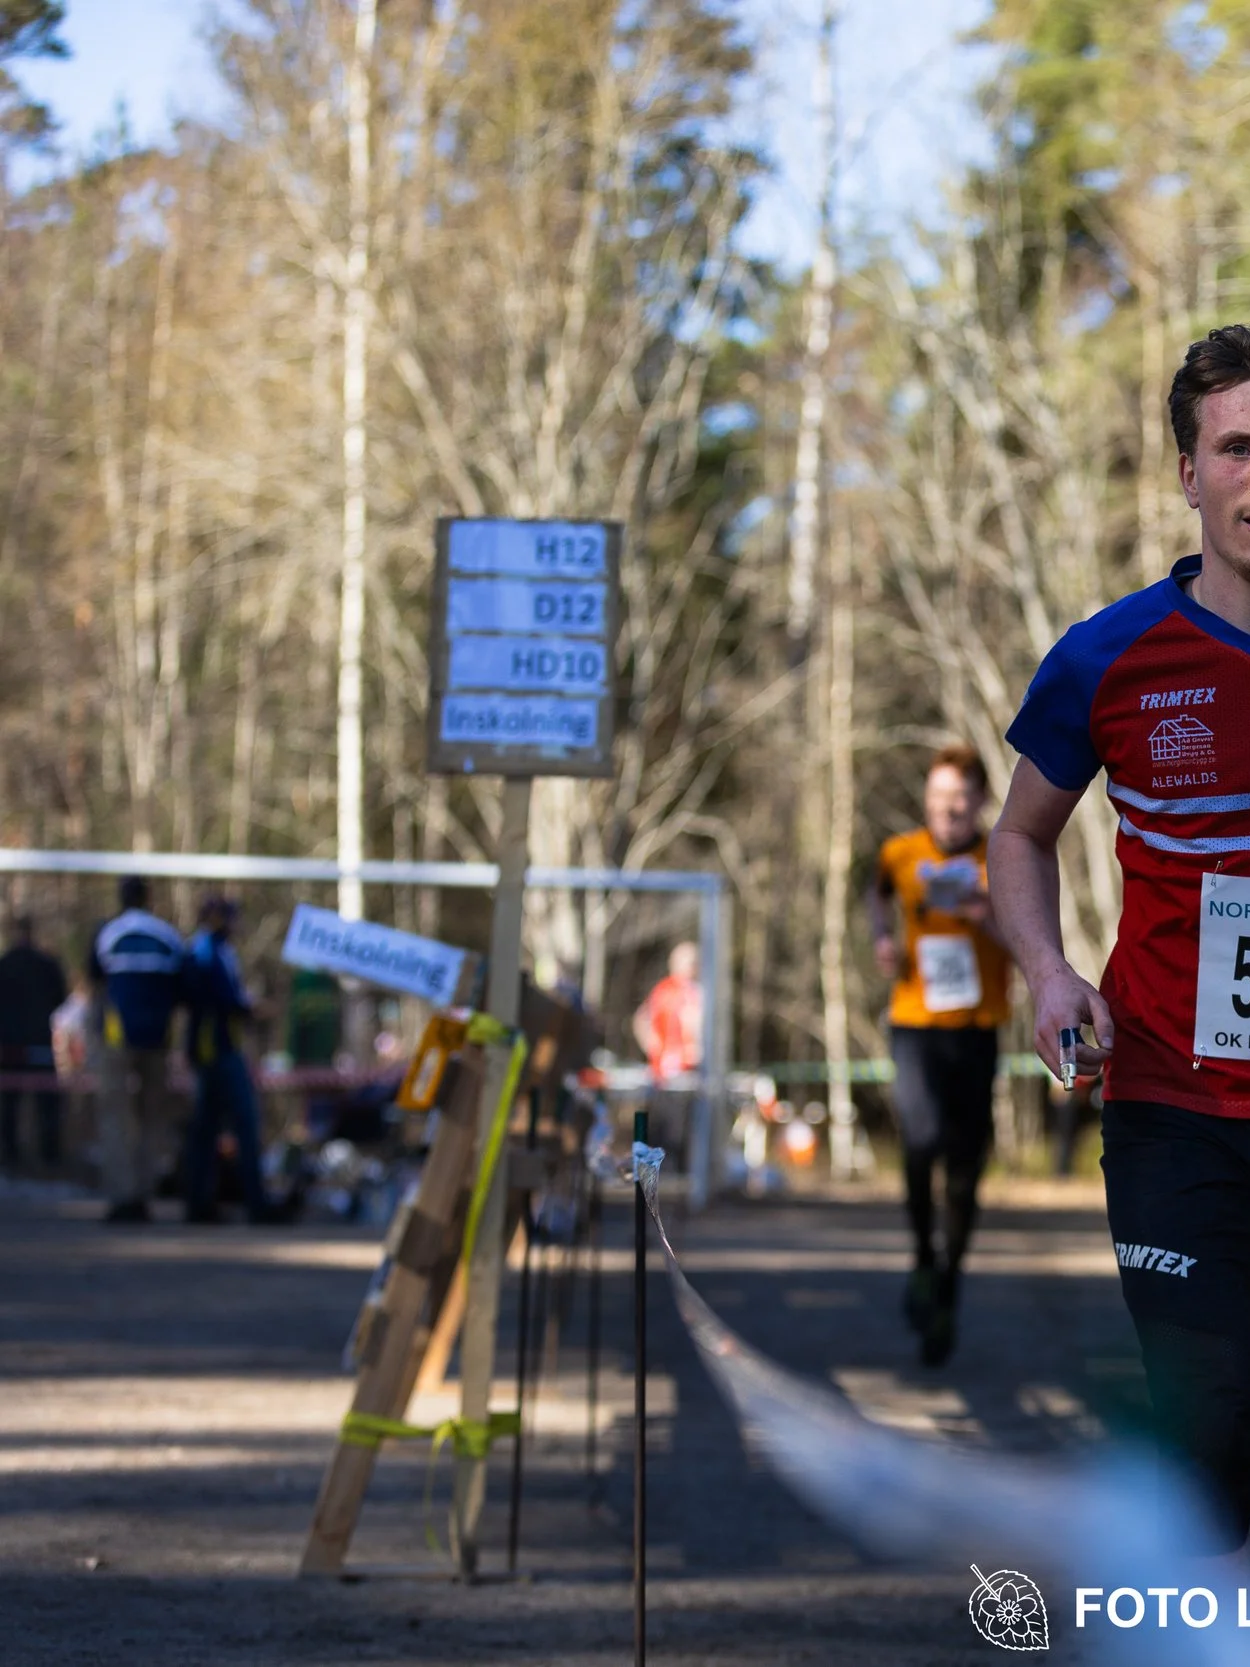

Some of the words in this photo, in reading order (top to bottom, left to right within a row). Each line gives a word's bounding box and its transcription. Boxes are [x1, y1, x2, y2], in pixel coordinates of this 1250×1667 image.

[534, 536, 600, 566] H12
[533, 593, 596, 623] D12
[510, 648, 601, 682] HD10
[1140, 687, 1217, 711] TRIMTEX
[446, 704, 589, 739] Inskolning
[1152, 771, 1218, 788] ALEWALDS
[299, 918, 447, 991] Inskolning
[1214, 1031, 1242, 1048] OK
[1115, 1242, 1198, 1278] TRIMTEX
